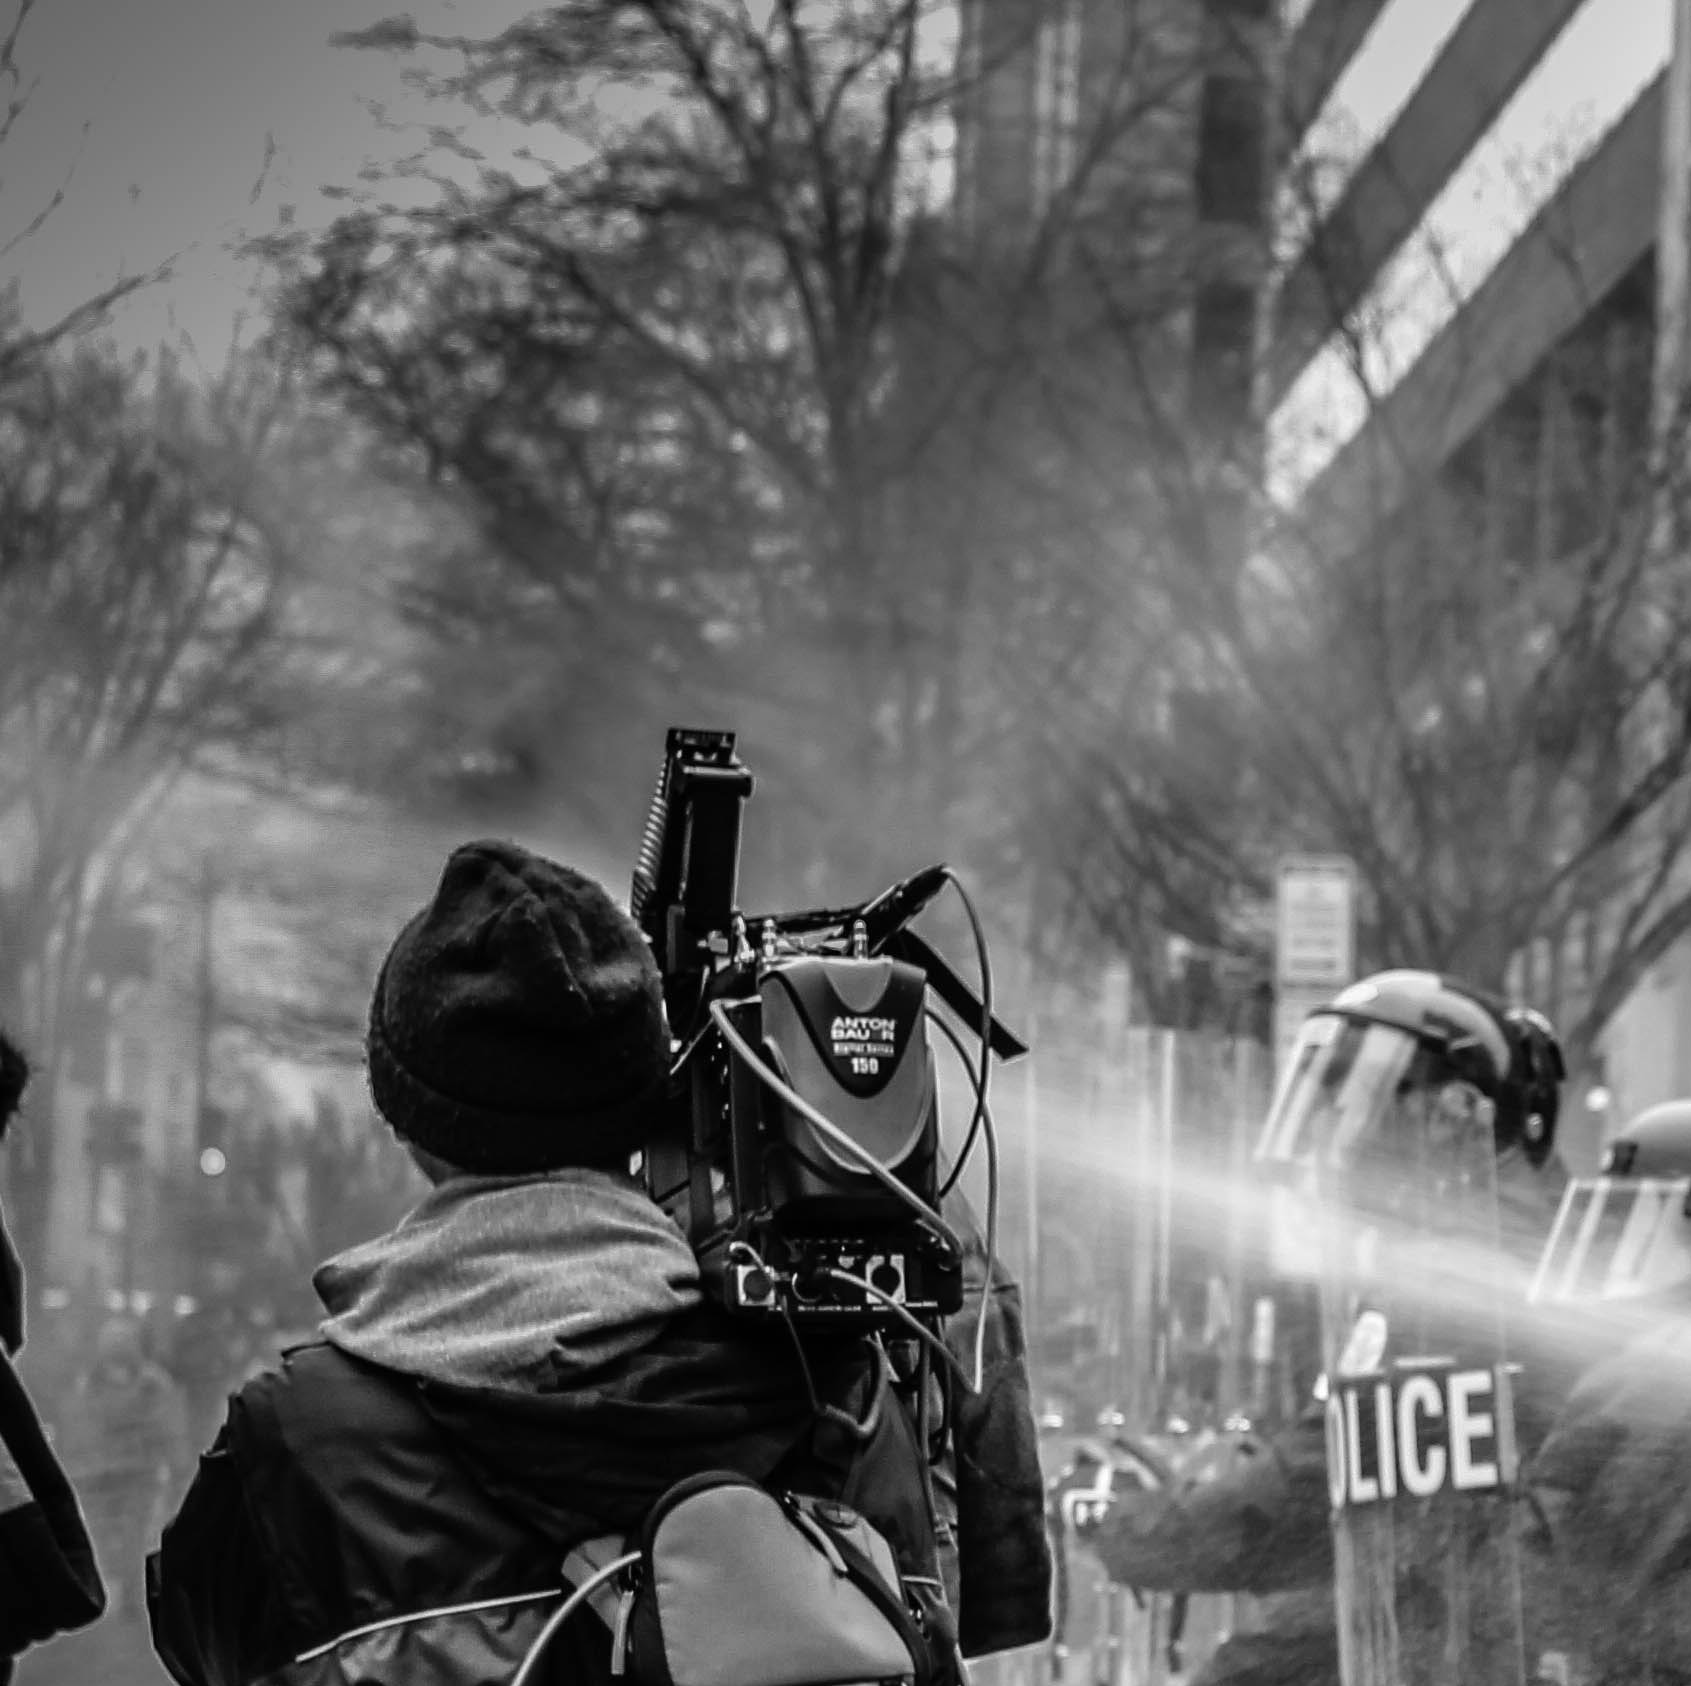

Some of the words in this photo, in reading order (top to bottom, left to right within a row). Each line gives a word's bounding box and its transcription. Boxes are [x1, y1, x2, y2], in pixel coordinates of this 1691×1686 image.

[831, 1016, 896, 1030] ANTON
[831, 1029, 895, 1041] BAUR
[851, 1057, 879, 1075] 150
[1324, 1368, 1499, 1510] OLICE
